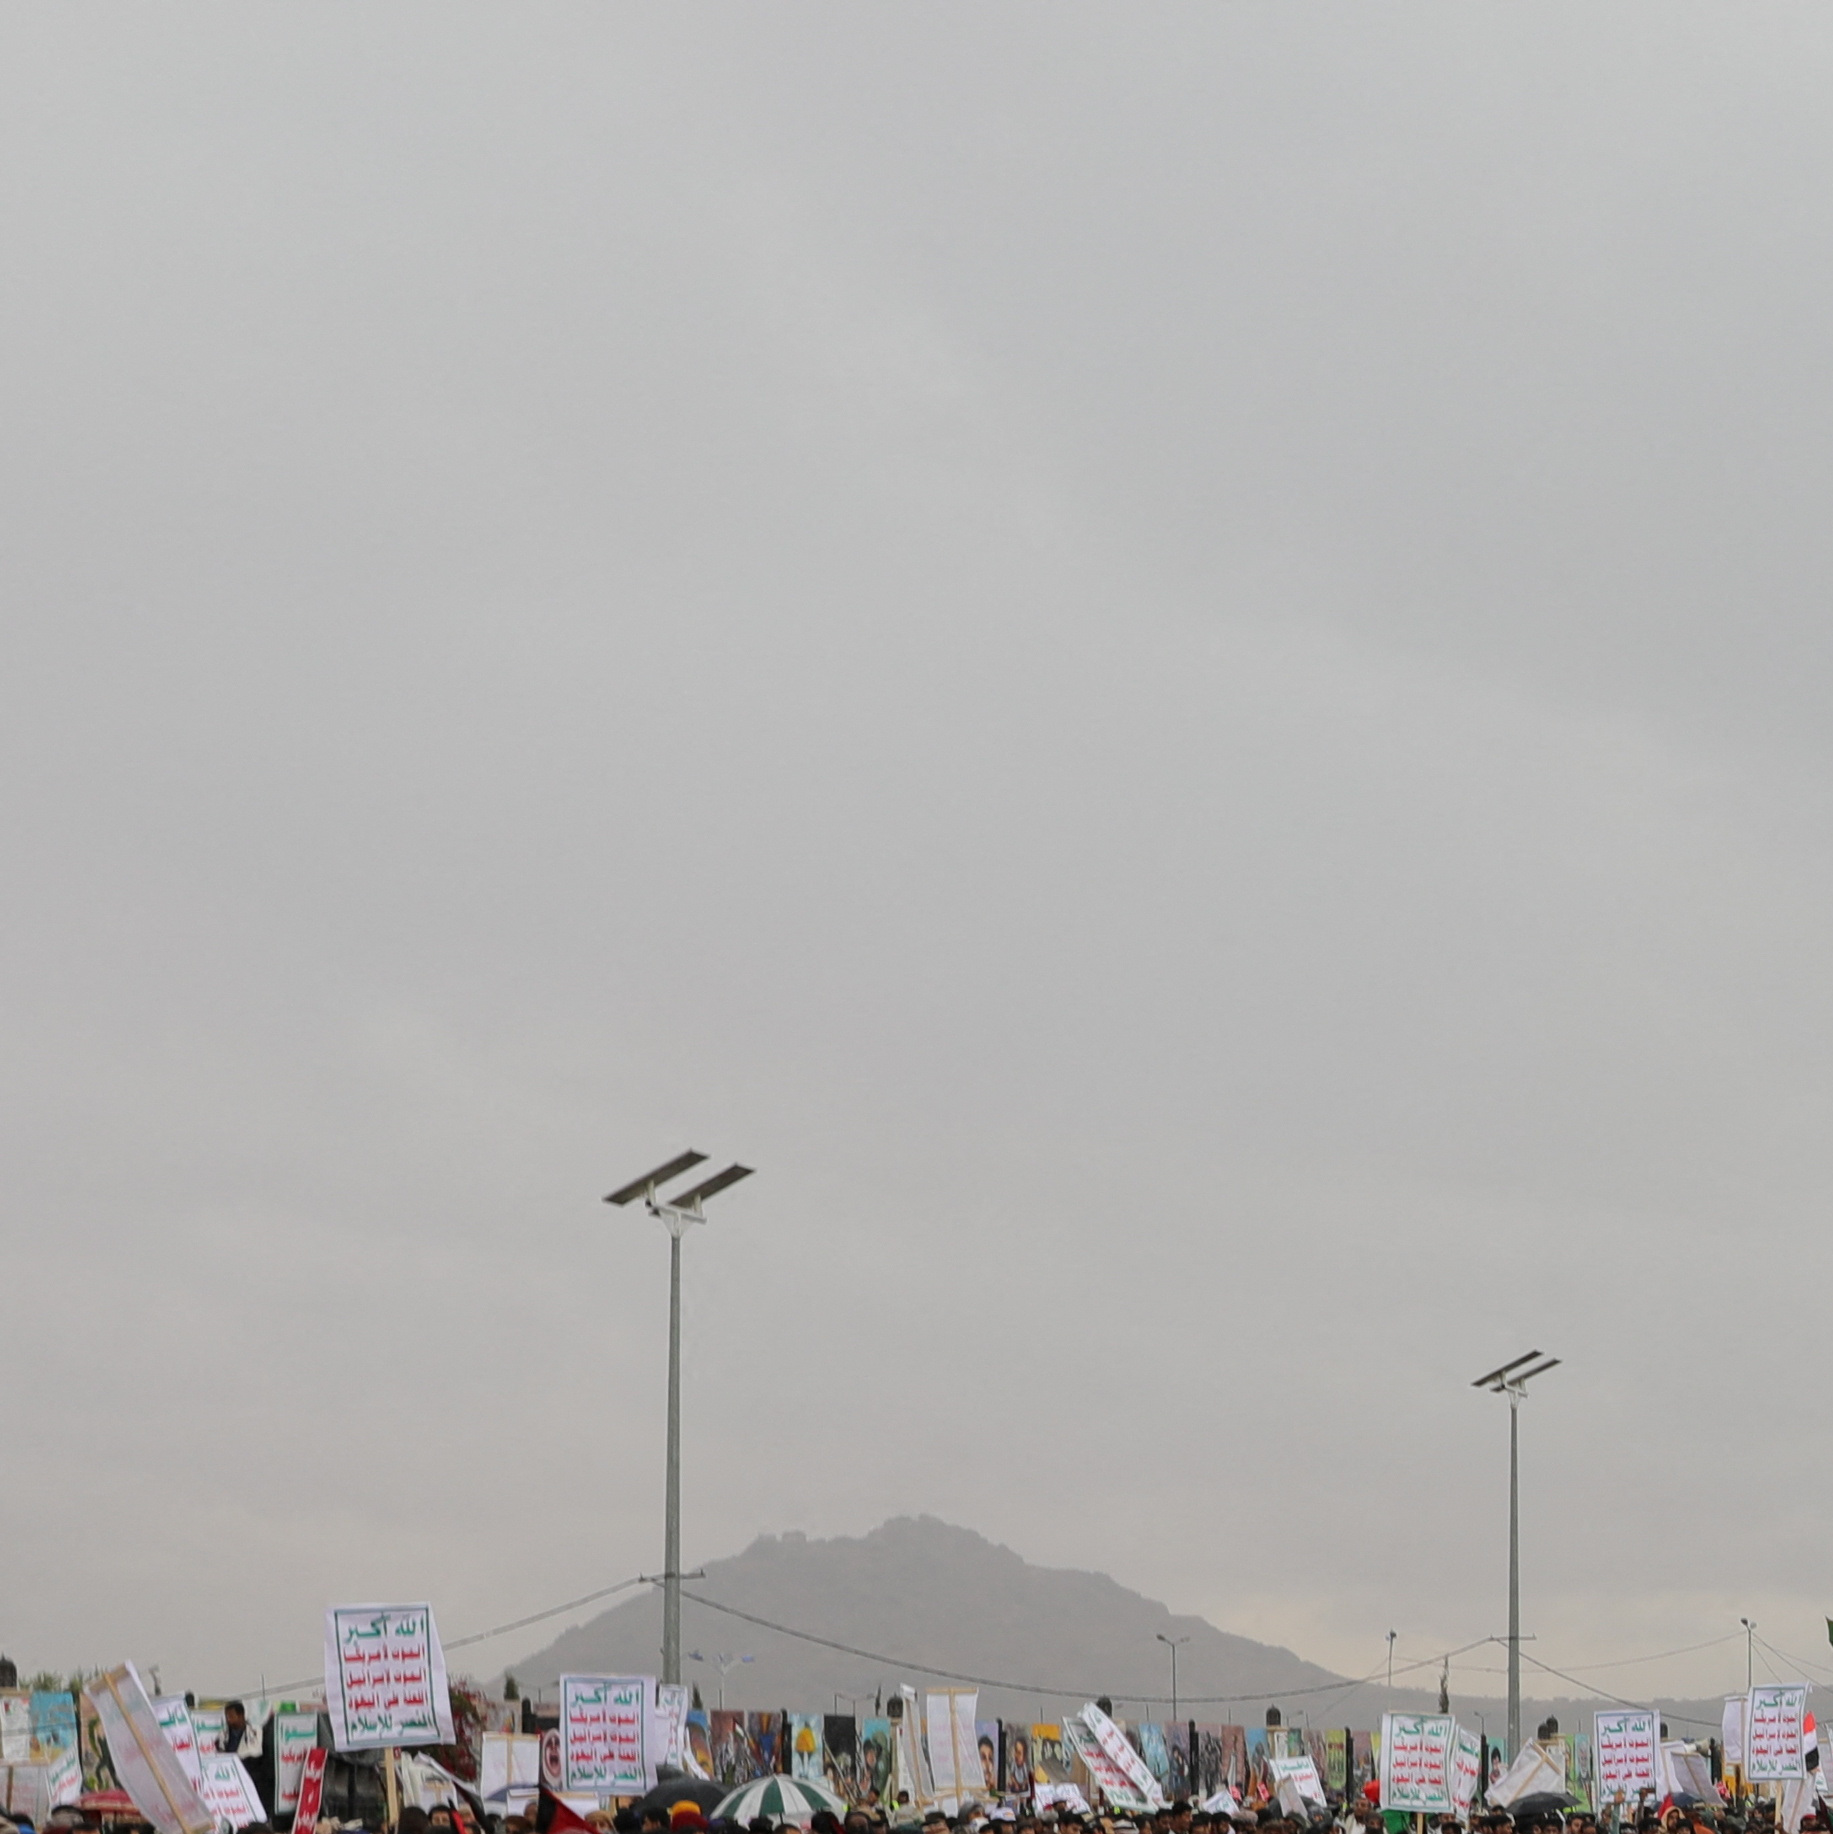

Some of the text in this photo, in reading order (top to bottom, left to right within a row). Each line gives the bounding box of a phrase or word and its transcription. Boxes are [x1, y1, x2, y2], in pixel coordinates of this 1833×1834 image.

[344, 1613, 424, 1643] الله أكبر
[392, 1644, 425, 1662] الموت
[394, 1668, 426, 1685] الموت
[571, 1684, 639, 1708] الله أكبر
[1786, 1693, 1802, 1707] الله
[609, 1713, 639, 1727] الموت
[1632, 1719, 1650, 1732] الله
[1783, 1714, 1798, 1725] الموت
[1428, 1723, 1447, 1737] الله
[1782, 1730, 1798, 1740] الموت
[610, 1731, 639, 1744] الموت
[1629, 1739, 1651, 1749] الموت
[1425, 1744, 1444, 1754] الموت
[1424, 1760, 1443, 1770] الموت
[1629, 1754, 1652, 1765] الموت
